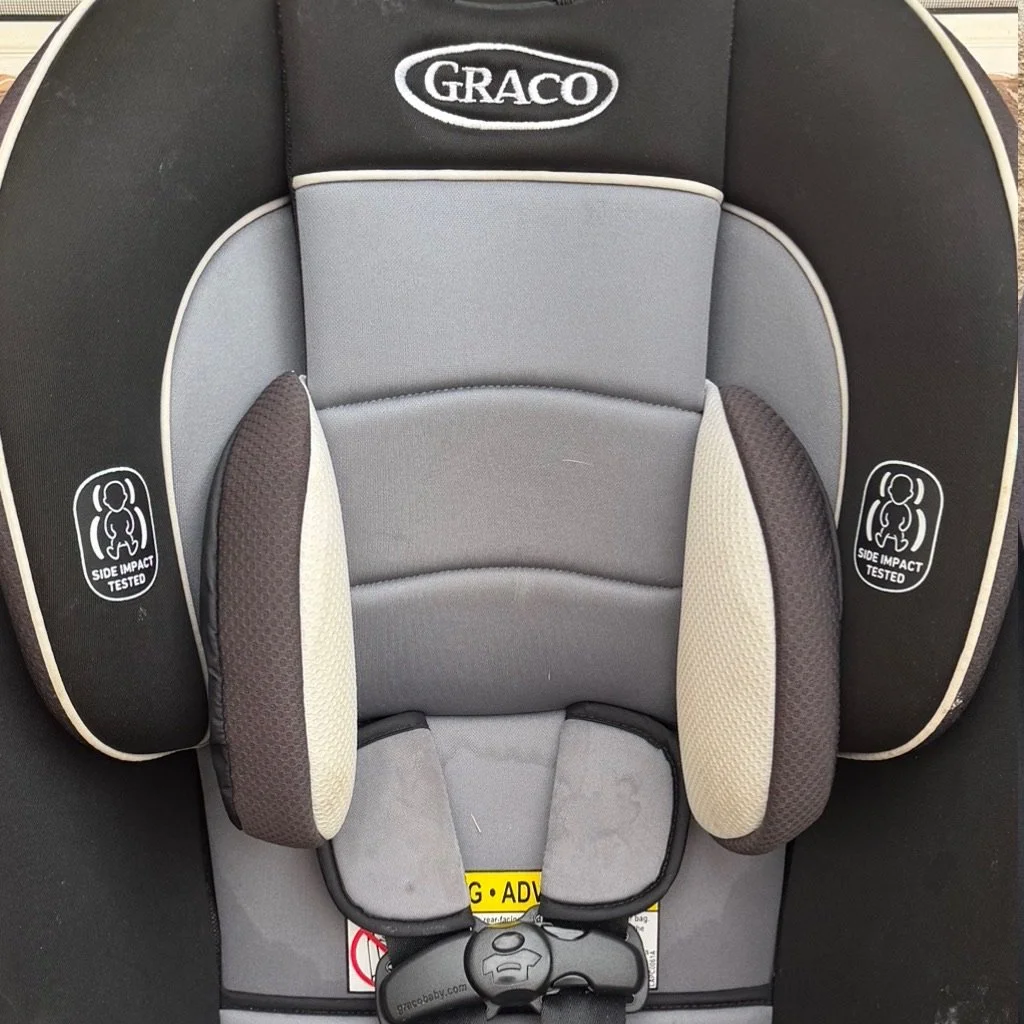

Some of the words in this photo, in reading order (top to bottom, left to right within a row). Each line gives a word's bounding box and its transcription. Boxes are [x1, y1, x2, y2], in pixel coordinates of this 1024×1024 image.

[424, 60, 599, 106] GRACO
[91, 565, 119, 581] SIDE
[119, 555, 154, 575] IMPACT
[858, 547, 880, 563] SIDE
[880, 554, 924, 573] IMPACT
[107, 573, 146, 592] TESTED
[866, 564, 906, 584] TESTED
[396, 983, 468, 1016] gracobaby.com
